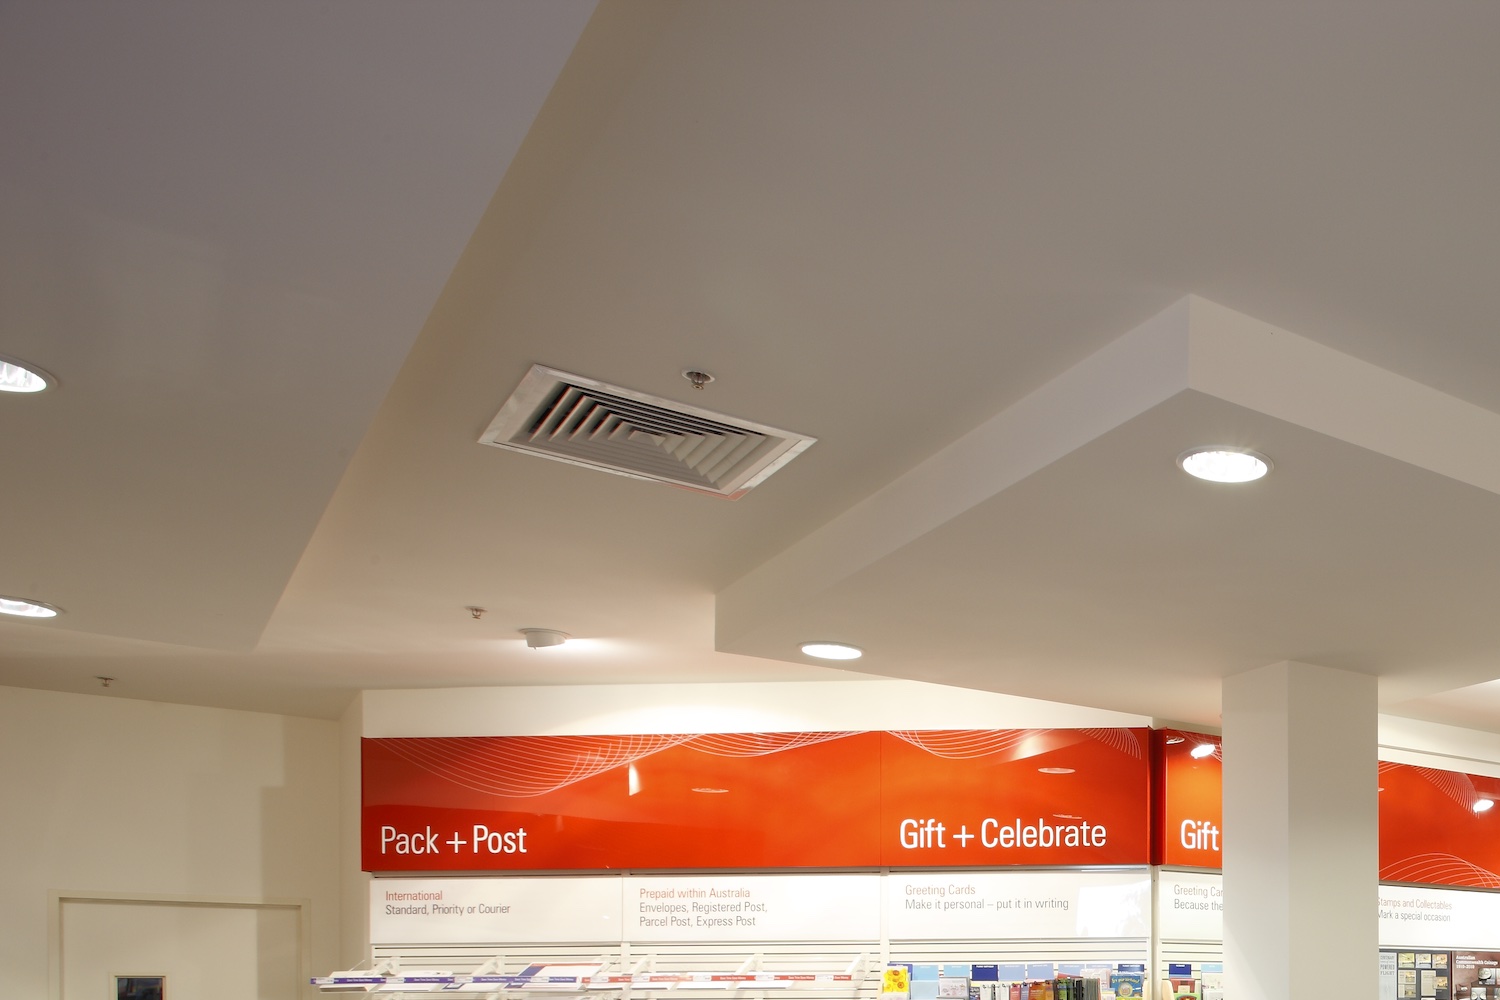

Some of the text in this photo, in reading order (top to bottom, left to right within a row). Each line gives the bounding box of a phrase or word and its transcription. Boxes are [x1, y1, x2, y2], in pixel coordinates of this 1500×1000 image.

[381, 825, 439, 855] Pack
[473, 824, 527, 854] Post
[899, 818, 946, 849] Gift
[981, 817, 1107, 848] Celebrate
[1180, 819, 1219, 851] Gift
[386, 890, 443, 901] International
[639, 887, 751, 901] Prepaid within Australia
[905, 884, 976, 899] Greeting Cards
[385, 903, 511, 917] Standard, Priority or Courier
[639, 901, 768, 915] Envelopes, Registered Post,
[905, 896, 1069, 912] Make it personal put it in writing
[1403, 899, 1414, 908] and
[1415, 899, 1452, 910] Collectables
[639, 915, 756, 928] Parcel Post, Express Post
[1401, 910, 1422, 922] special
[1423, 912, 1451, 922] occasion
